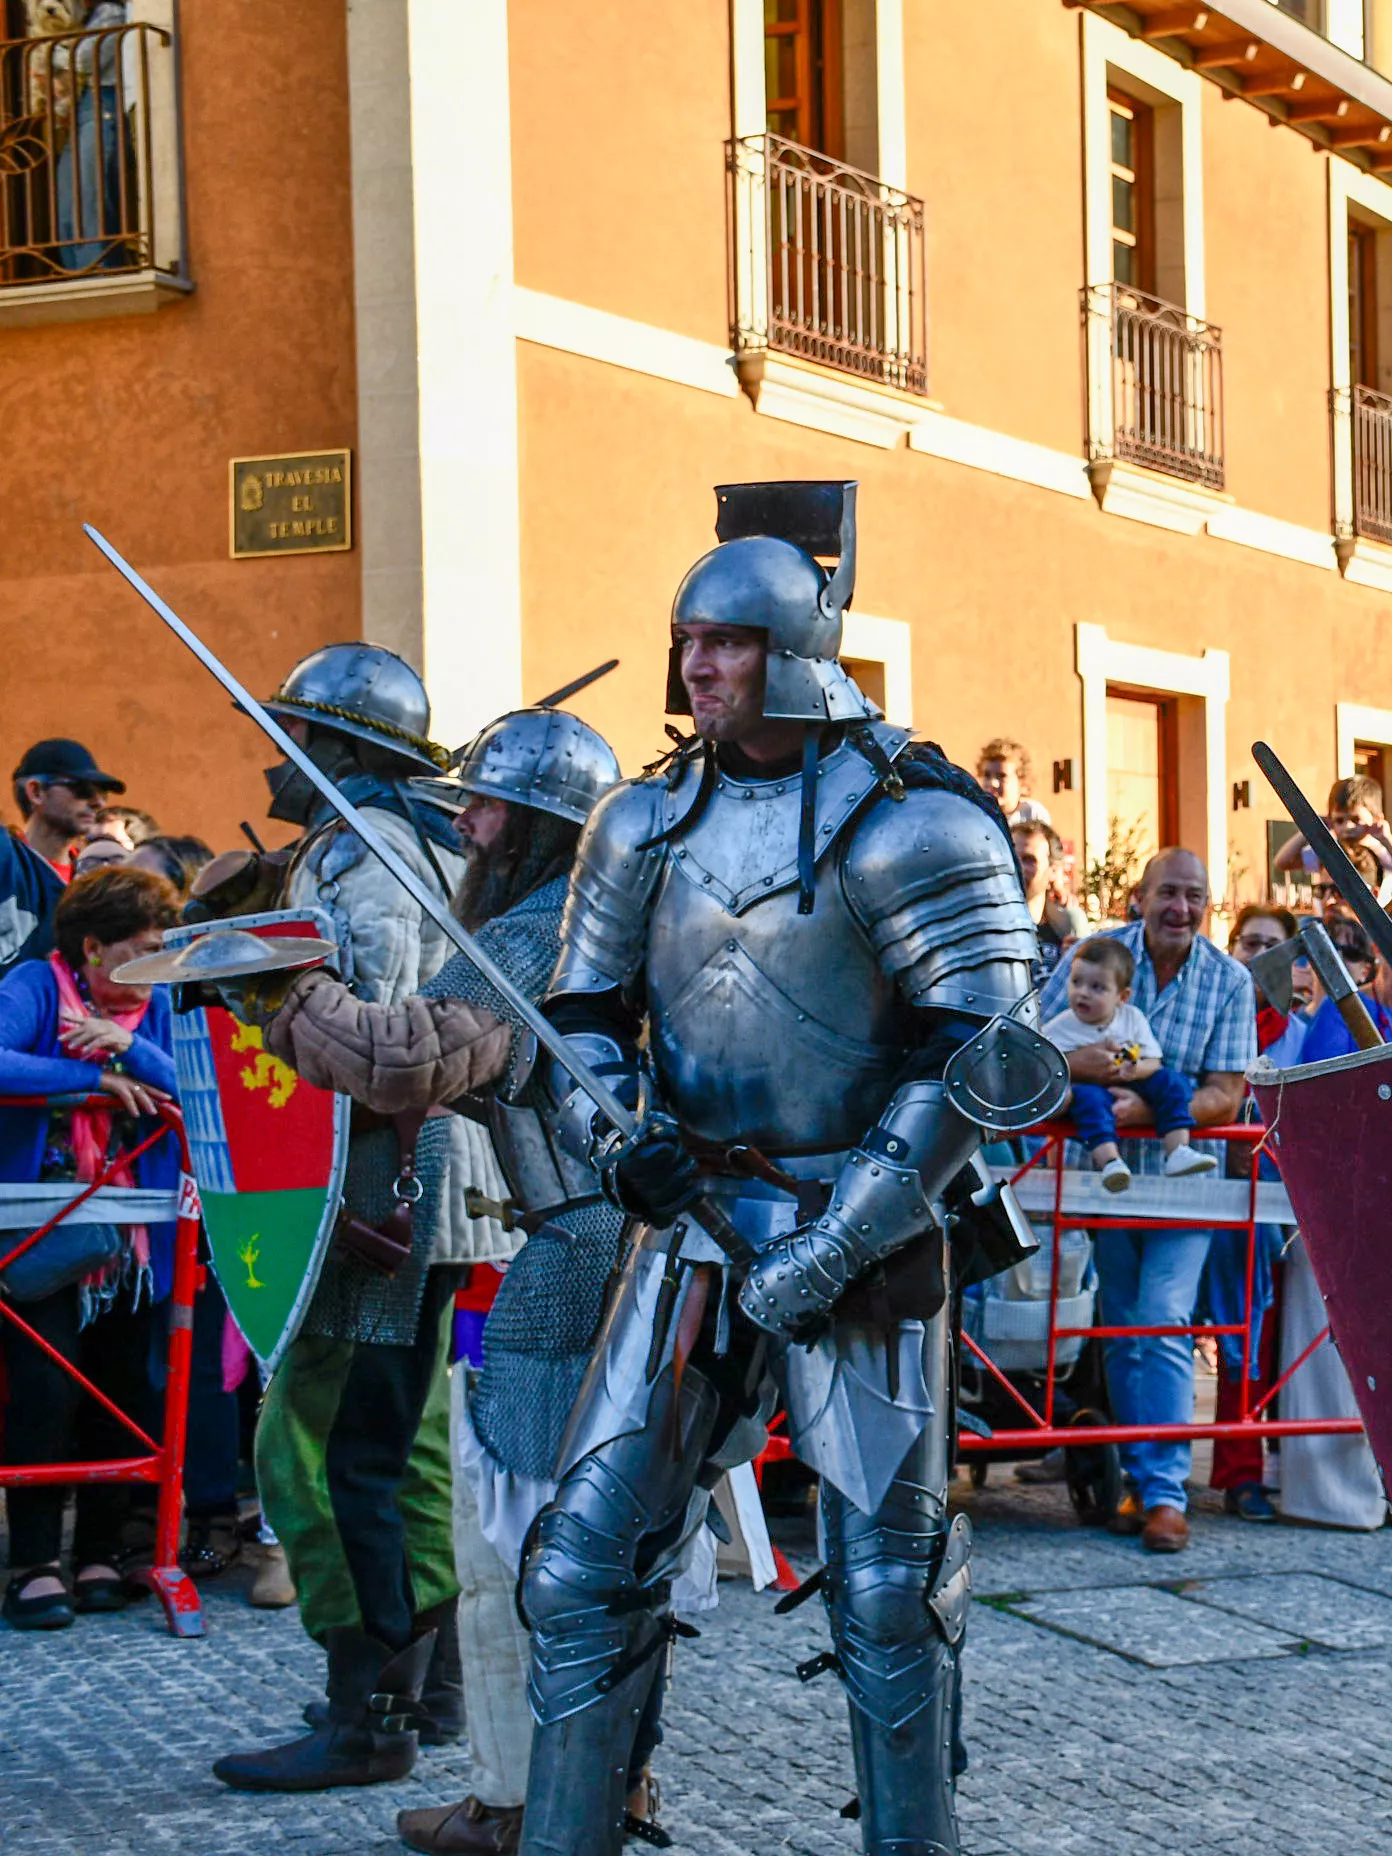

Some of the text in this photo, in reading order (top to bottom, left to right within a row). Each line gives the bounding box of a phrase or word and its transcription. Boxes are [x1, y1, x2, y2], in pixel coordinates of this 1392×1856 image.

[266, 468, 342, 488] TRAVESIA
[292, 495, 314, 512] EL
[269, 517, 337, 539] TEMPLE
